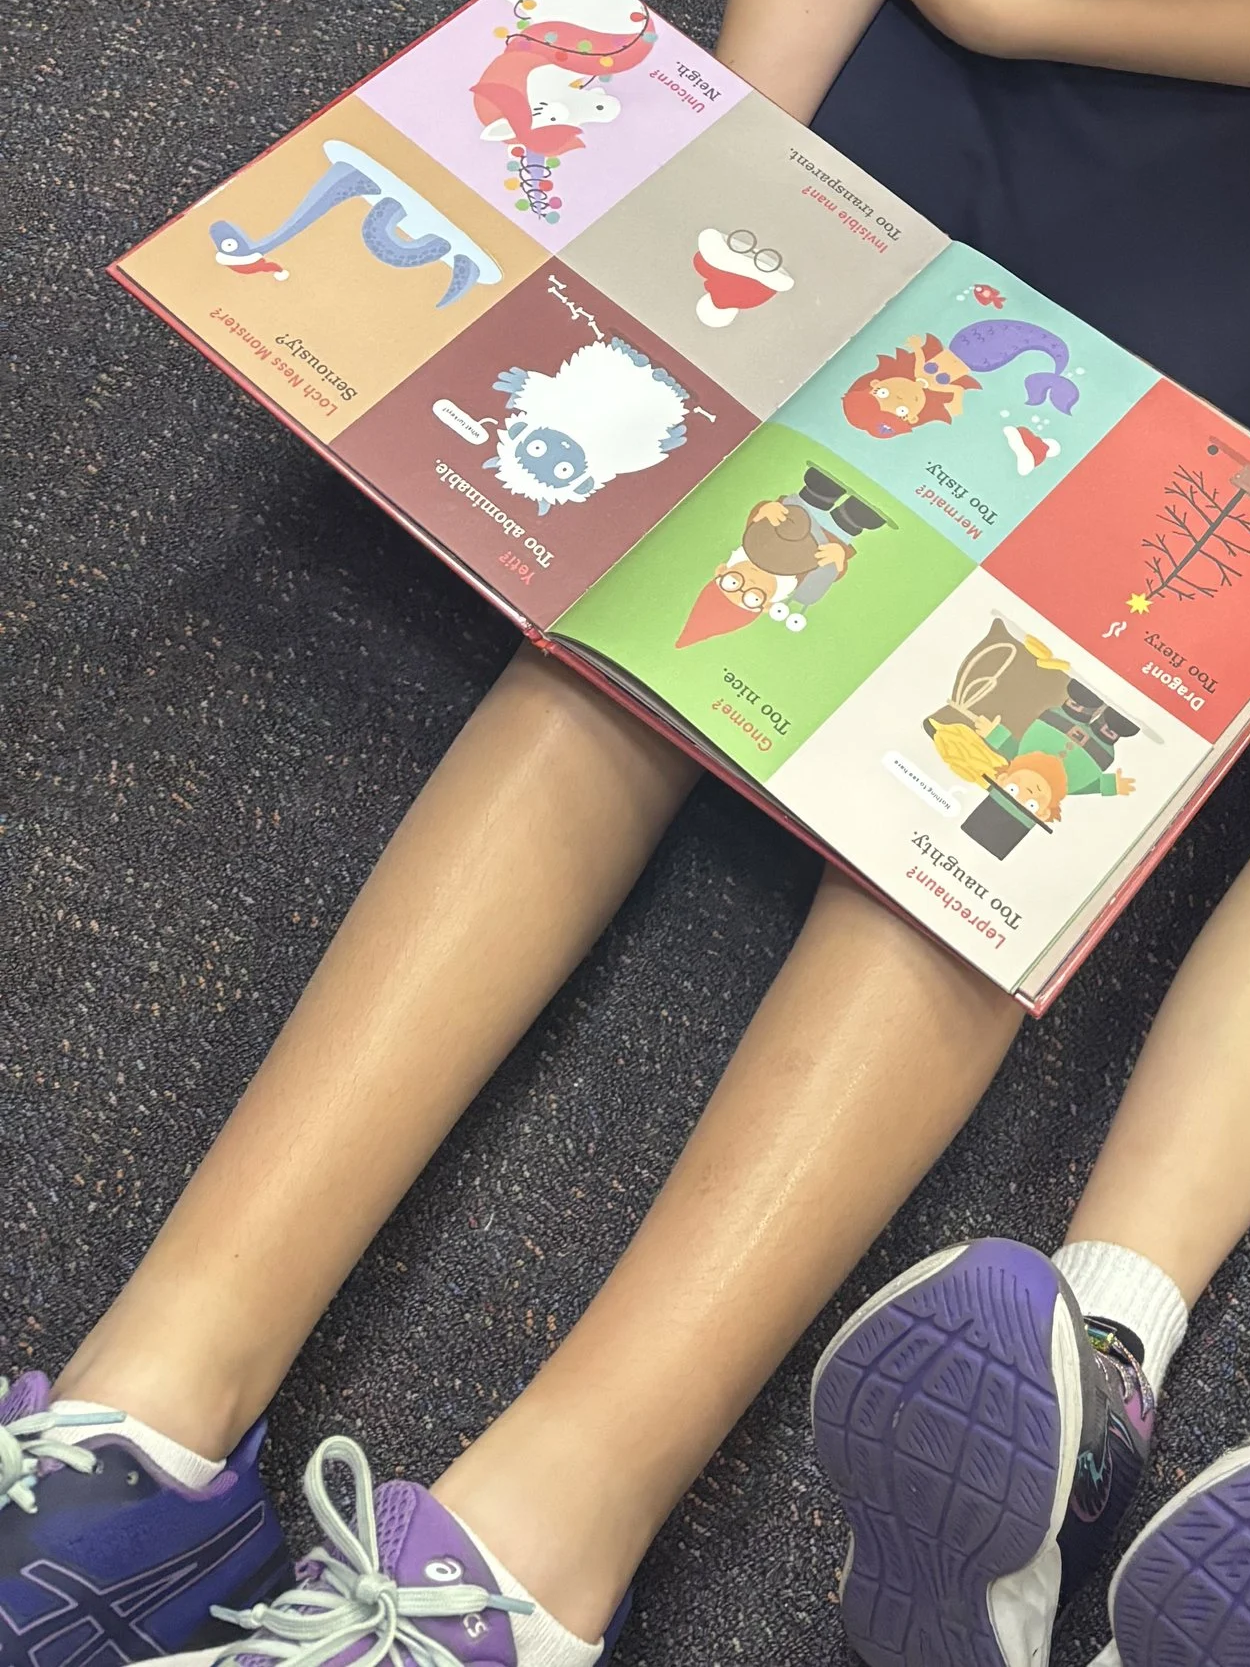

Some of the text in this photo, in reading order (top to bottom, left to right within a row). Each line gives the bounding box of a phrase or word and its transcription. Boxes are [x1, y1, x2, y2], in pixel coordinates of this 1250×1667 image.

[649, 68, 705, 114] Unicorn?
[676, 61, 722, 102] Neigh.
[789, 147, 902, 242] Too transparent.
[801, 185, 888, 253] Invisible man?
[209, 307, 338, 417] Loch Ness Monster?
[275, 333, 358, 401] Seriously?
[435, 459, 555, 568] Too abominable.
[915, 484, 983, 540] Mermaid?
[926, 461, 998, 526] Too fishy.
[499, 550, 536, 585] Yeti?
[1141, 661, 1206, 711] Dragon?
[1144, 630, 1219, 695] Too fiery.
[711, 698, 773, 752] Gnome?
[723, 668, 791, 736] Too nice.
[905, 865, 1006, 950] Leprechaun?
[911, 831, 1022, 931] Too naughty.
